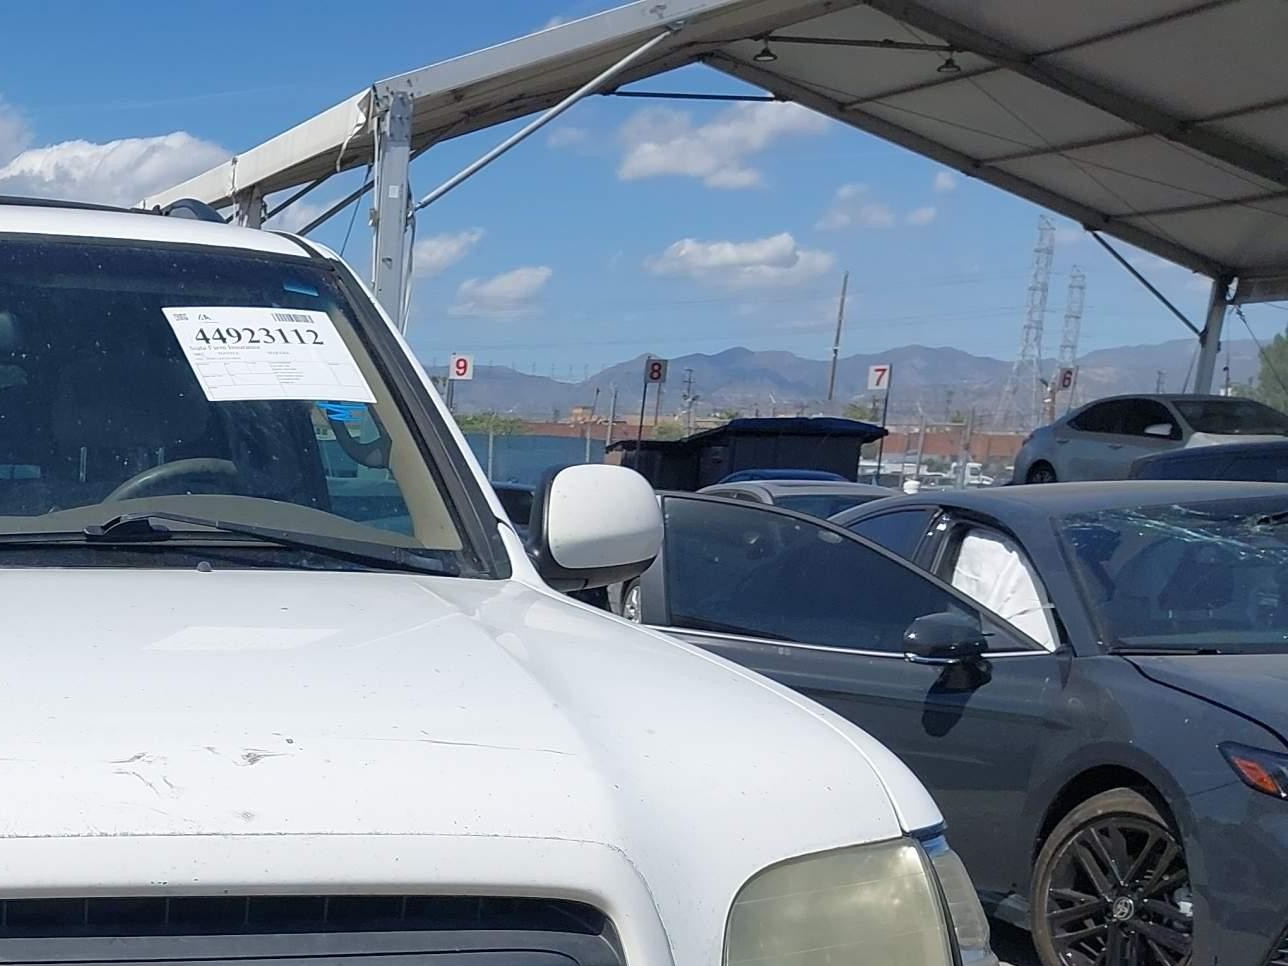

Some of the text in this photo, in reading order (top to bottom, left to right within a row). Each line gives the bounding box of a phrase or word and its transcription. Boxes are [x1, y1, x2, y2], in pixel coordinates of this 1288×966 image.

[195, 327, 325, 346] 44923112
[455, 358, 468, 376] 9
[650, 362, 662, 380] 8
[874, 368, 887, 386] 7
[1062, 370, 1073, 388] 6
